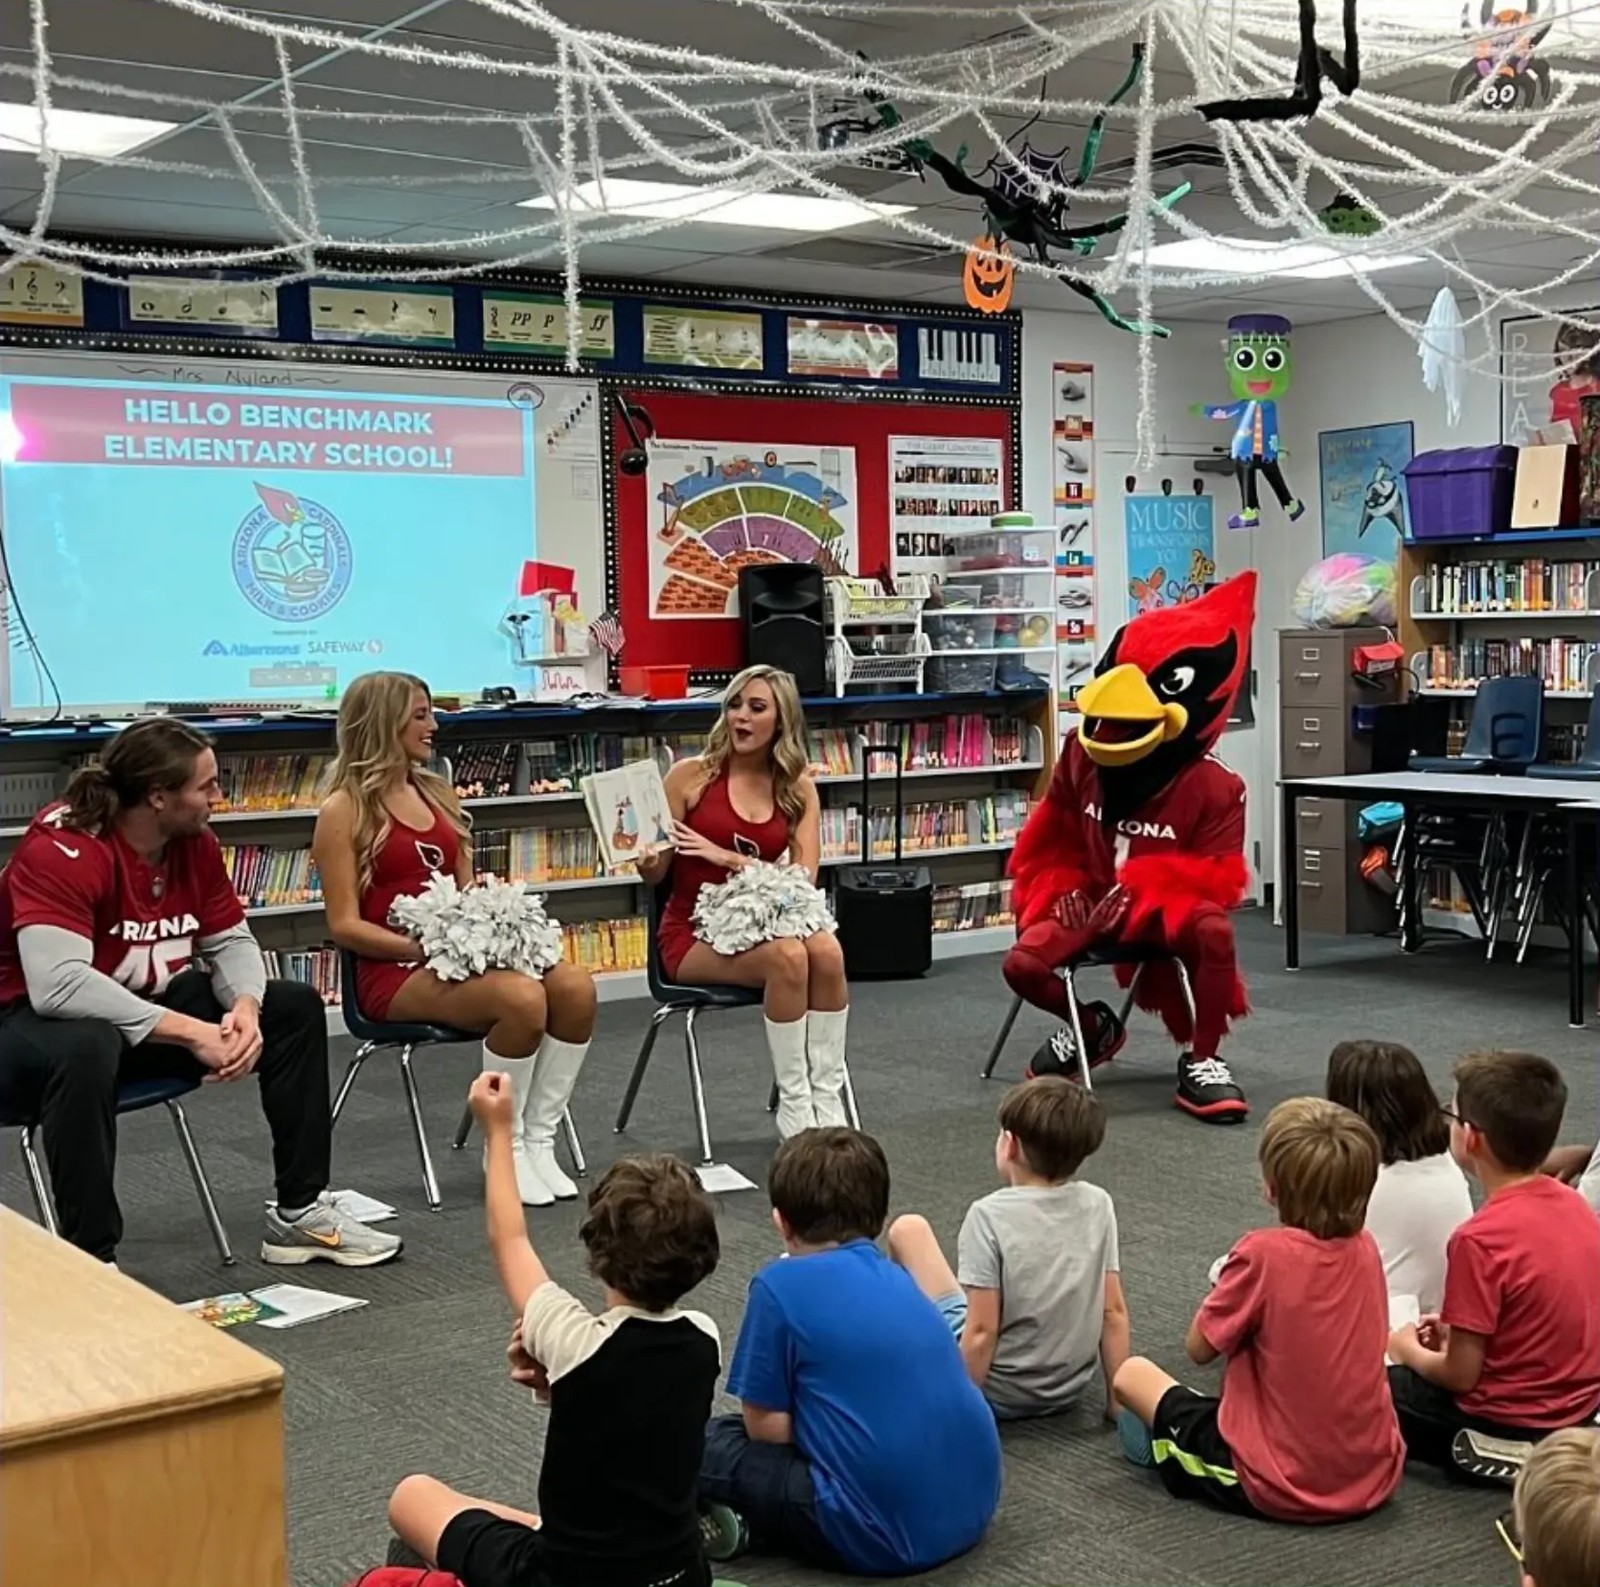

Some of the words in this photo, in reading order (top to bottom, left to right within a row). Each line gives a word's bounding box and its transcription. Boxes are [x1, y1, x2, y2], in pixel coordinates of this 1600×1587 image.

[172, 367, 203, 382] Mrs
[225, 368, 292, 387] Nyland
[1511, 332, 1530, 446] REA
[124, 398, 231, 427] HELLO
[240, 404, 433, 434] BENCHMARK
[104, 434, 316, 464] ELEMENTARY
[324, 441, 453, 469] SCHOOL!
[1069, 484, 1078, 496] Ti
[1130, 501, 1209, 532] MUSIC
[237, 511, 269, 568] ARIZONA
[290, 582, 342, 617] COOKIES
[307, 641, 366, 654] SAFEWAY
